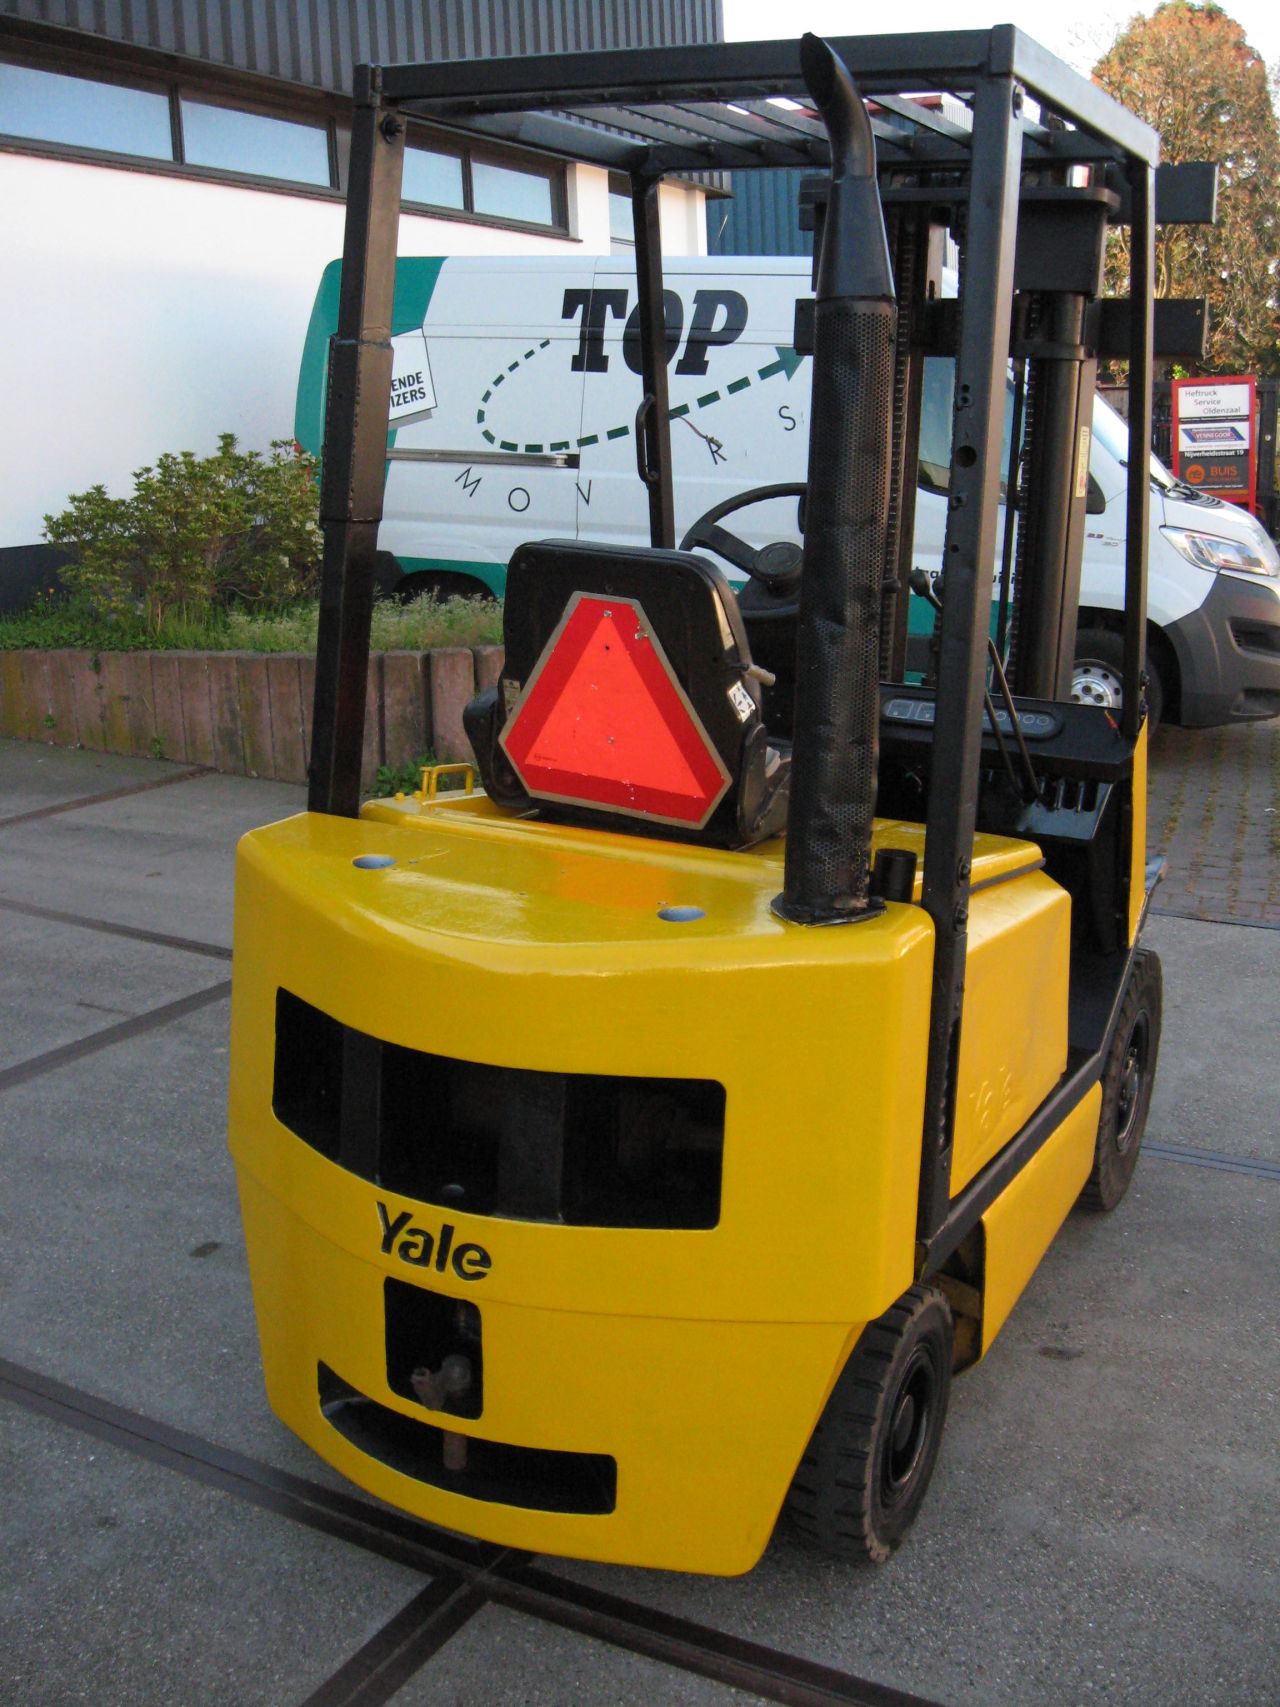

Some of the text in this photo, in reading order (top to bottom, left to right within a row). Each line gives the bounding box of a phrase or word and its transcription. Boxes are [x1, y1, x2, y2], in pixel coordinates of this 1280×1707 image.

[561, 288, 748, 376] TOP
[390, 387, 426, 408] IZERS
[391, 371, 424, 391] ENDE
[1203, 406, 1241, 415] Oldenzaal
[455, 405, 796, 512] MOVRS
[376, 1200, 492, 1281] Yale
